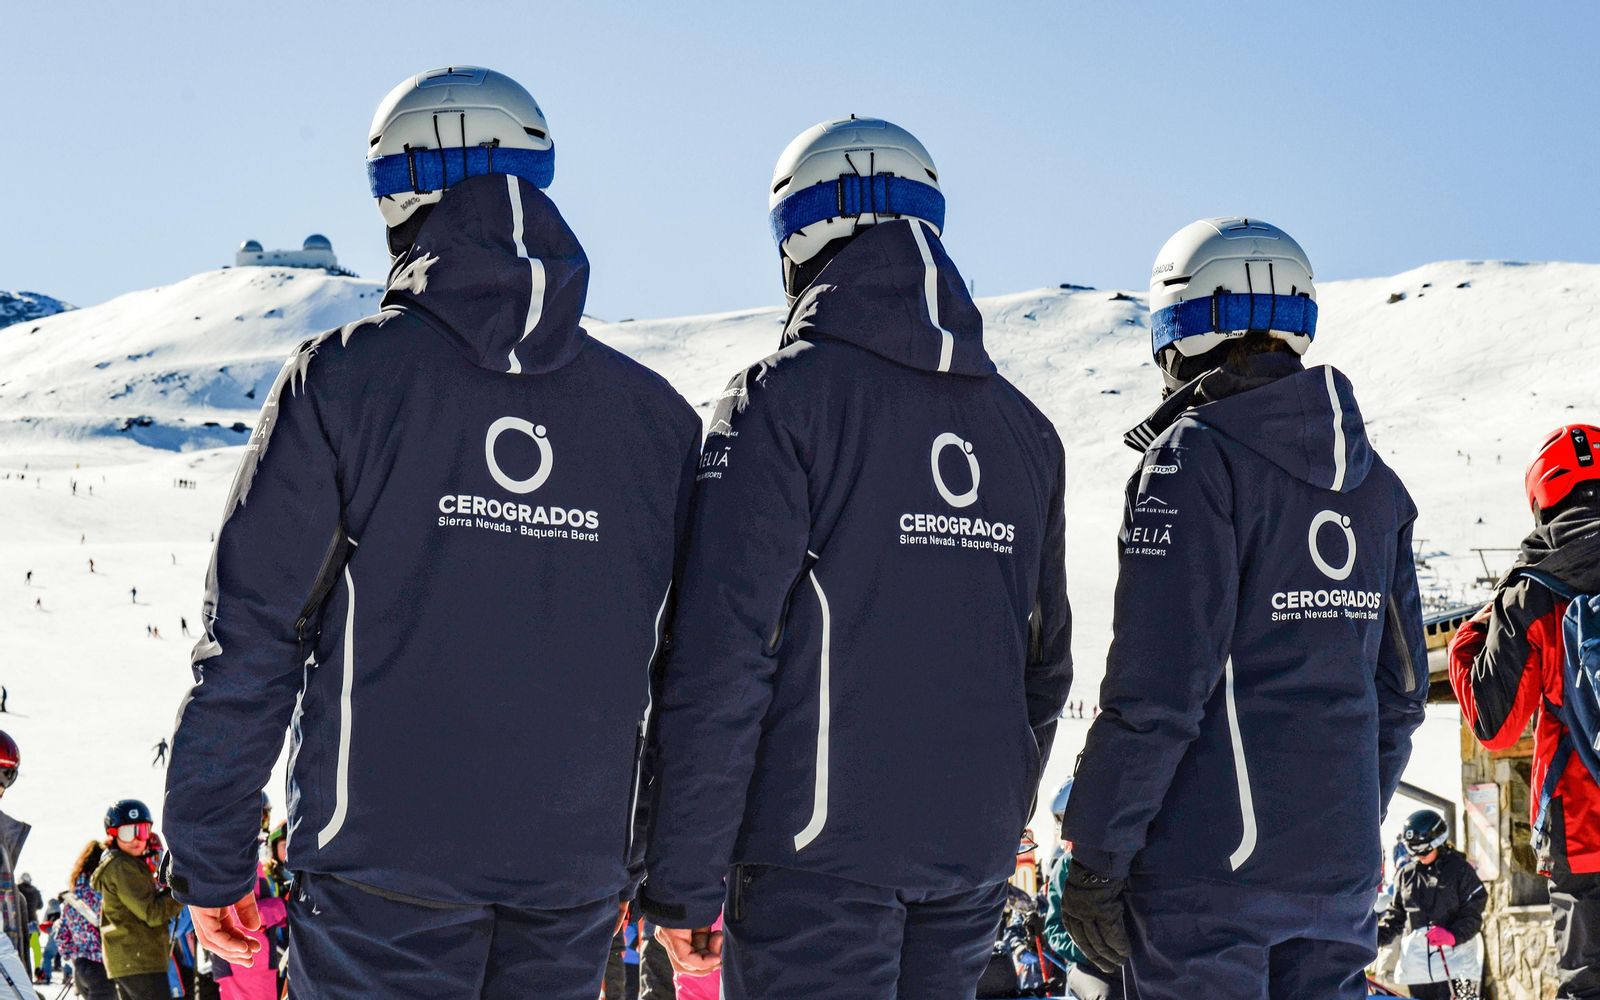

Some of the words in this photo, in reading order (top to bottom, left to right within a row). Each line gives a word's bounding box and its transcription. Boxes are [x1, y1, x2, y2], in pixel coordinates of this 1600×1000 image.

[438, 494, 599, 529] CEROGRADOS
[438, 516, 472, 527] Sierra
[475, 517, 512, 533] Nevada
[520, 525, 568, 539] Baqueira
[571, 530, 599, 542] Beret
[900, 534, 928, 544] Sierra
[929, 535, 956, 546] Nevada
[1141, 548, 1166, 556] RESORTS
[1271, 589, 1381, 609] CEROGRADOS
[1271, 612, 1302, 621] Sierra
[1304, 609, 1338, 619] Nevada
